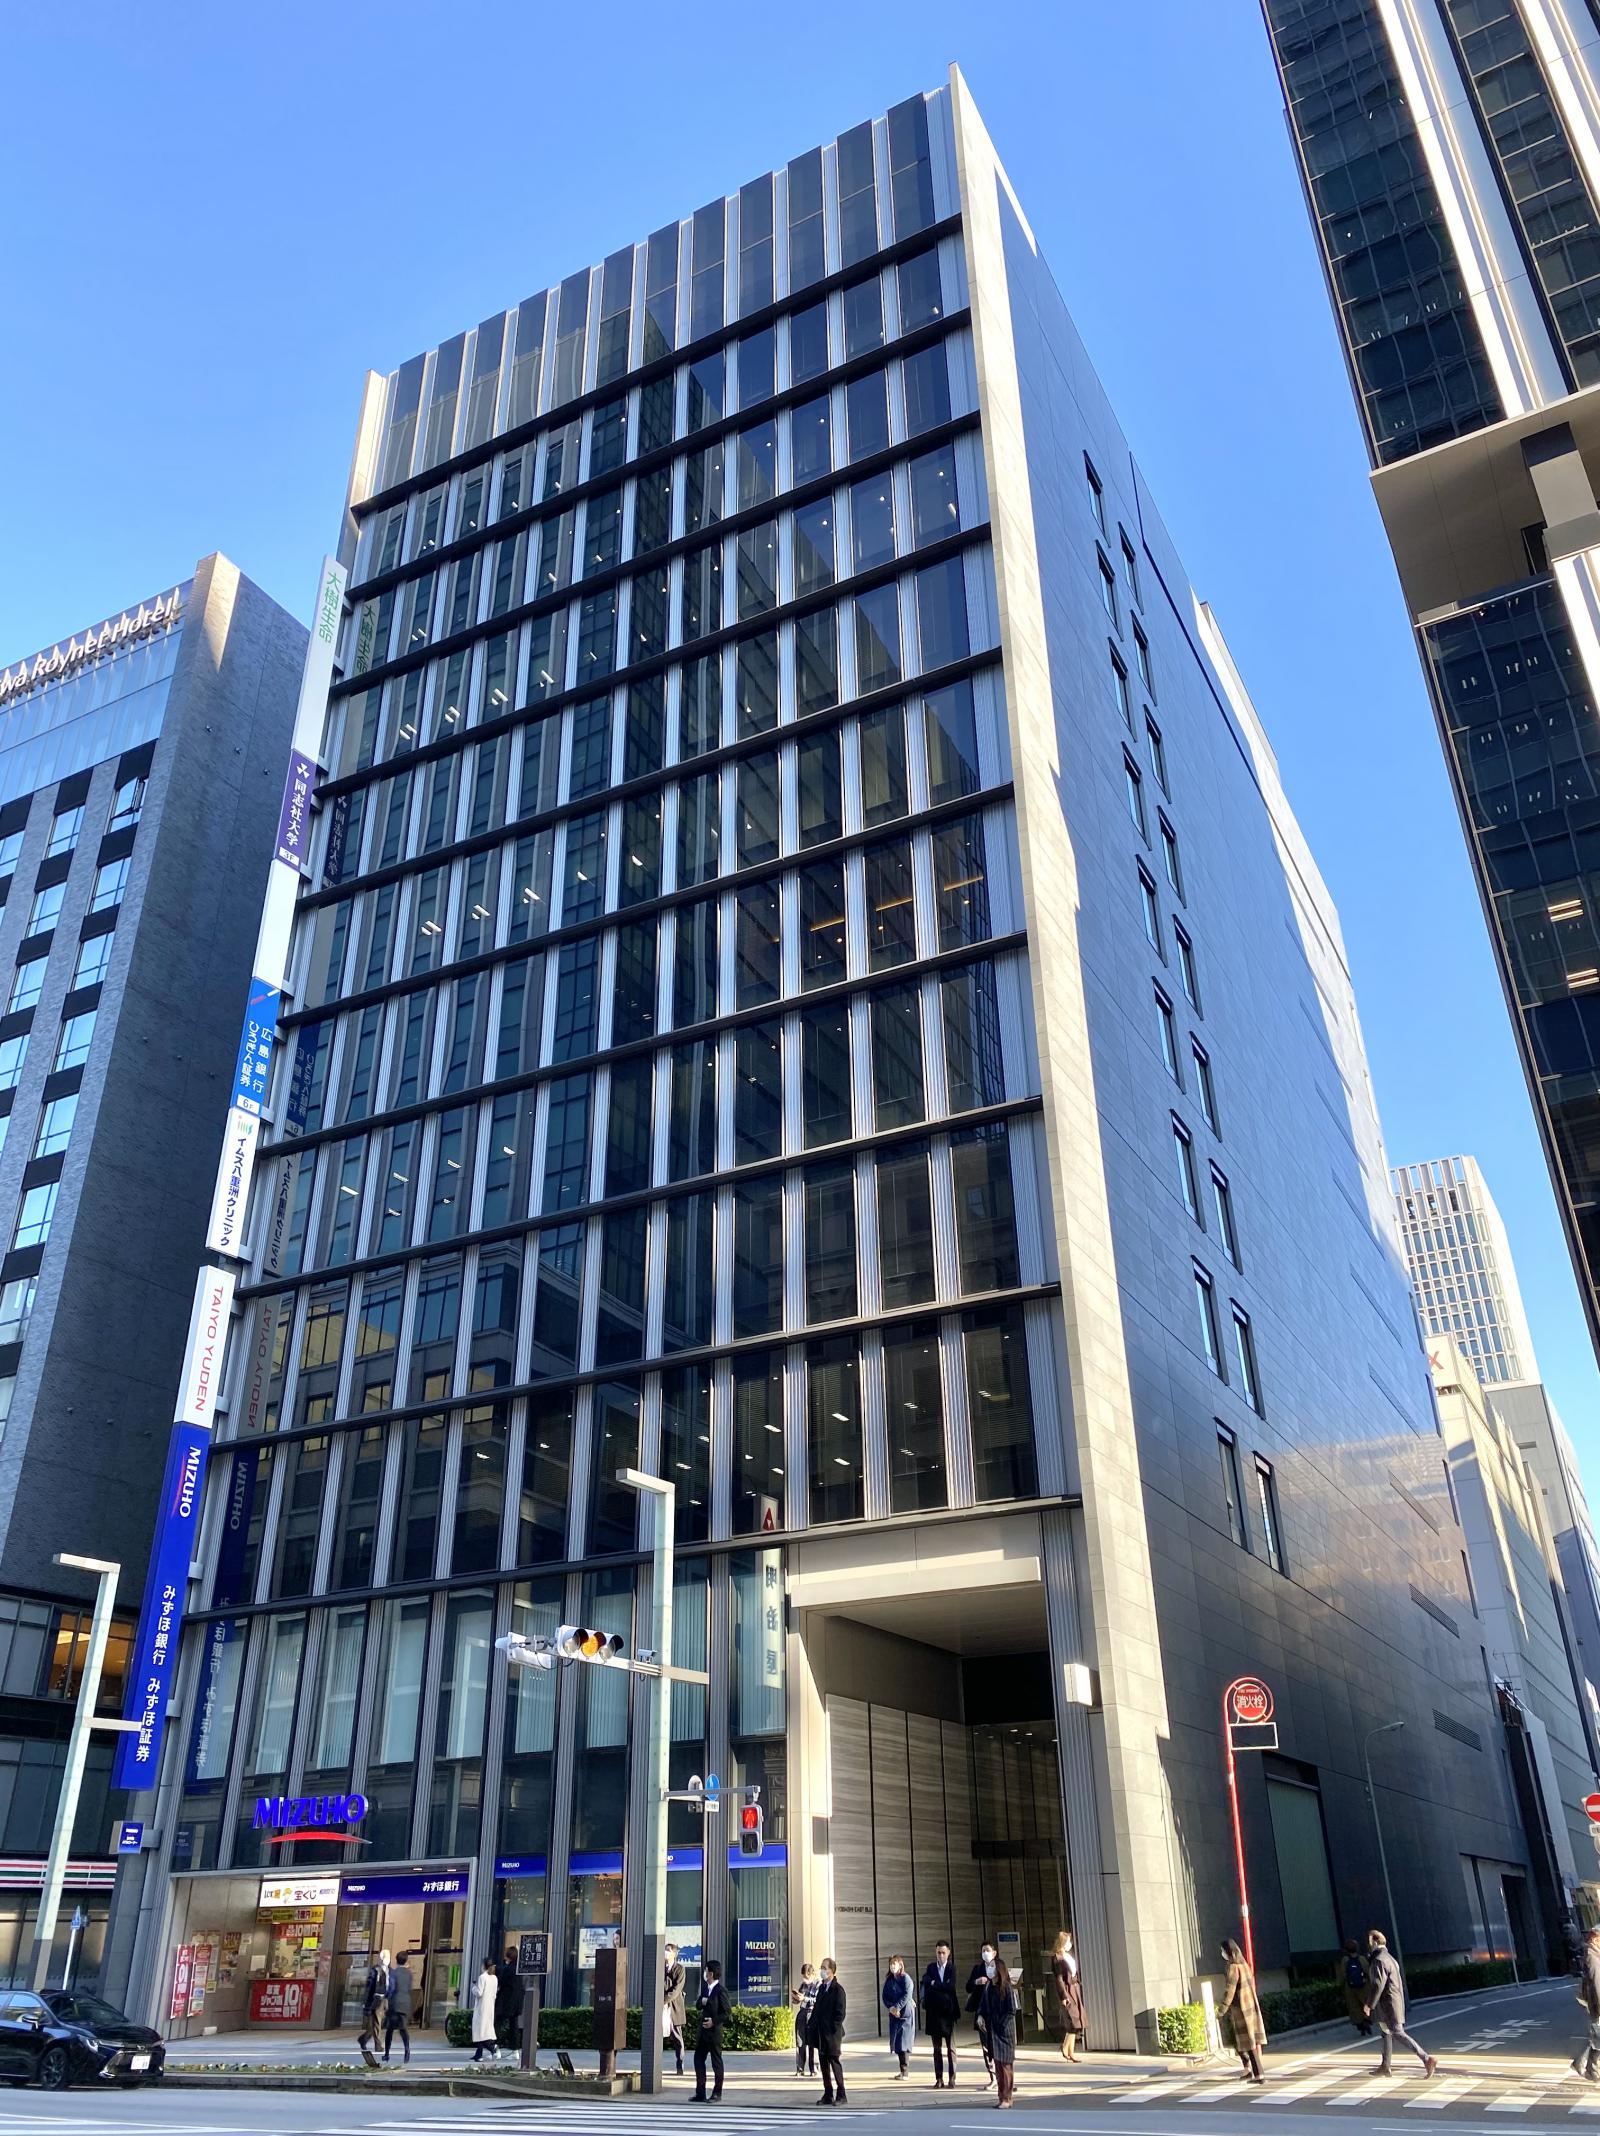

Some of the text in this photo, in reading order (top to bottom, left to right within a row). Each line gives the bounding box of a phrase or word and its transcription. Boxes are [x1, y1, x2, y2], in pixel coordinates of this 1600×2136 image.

[319, 572, 342, 643] 大樹生命
[0, 596, 174, 697] wa Roynet Hotel
[286, 778, 307, 846] 同志社大学
[284, 850, 294, 861] 3F
[240, 1020, 259, 1087] ひろぎん証券
[252, 1027, 273, 1094] 広島銀行
[243, 1098, 254, 1109] 6F
[220, 1138, 247, 1246] イムス八重洲クリニック
[195, 1287, 224, 1411] TAIYO YUDEN
[179, 1446, 202, 1518] MIZUHO
[136, 1585, 176, 1762] みずほ銀行 みずほ証券
[1237, 1694, 1264, 1709] 消火栓
[252, 1794, 368, 1829] MIZUHO
[294, 1889, 317, 1901] 宝くじ
[422, 1881, 460, 1892] みずほ銀行
[745, 1941, 776, 1950] MIZUHO
